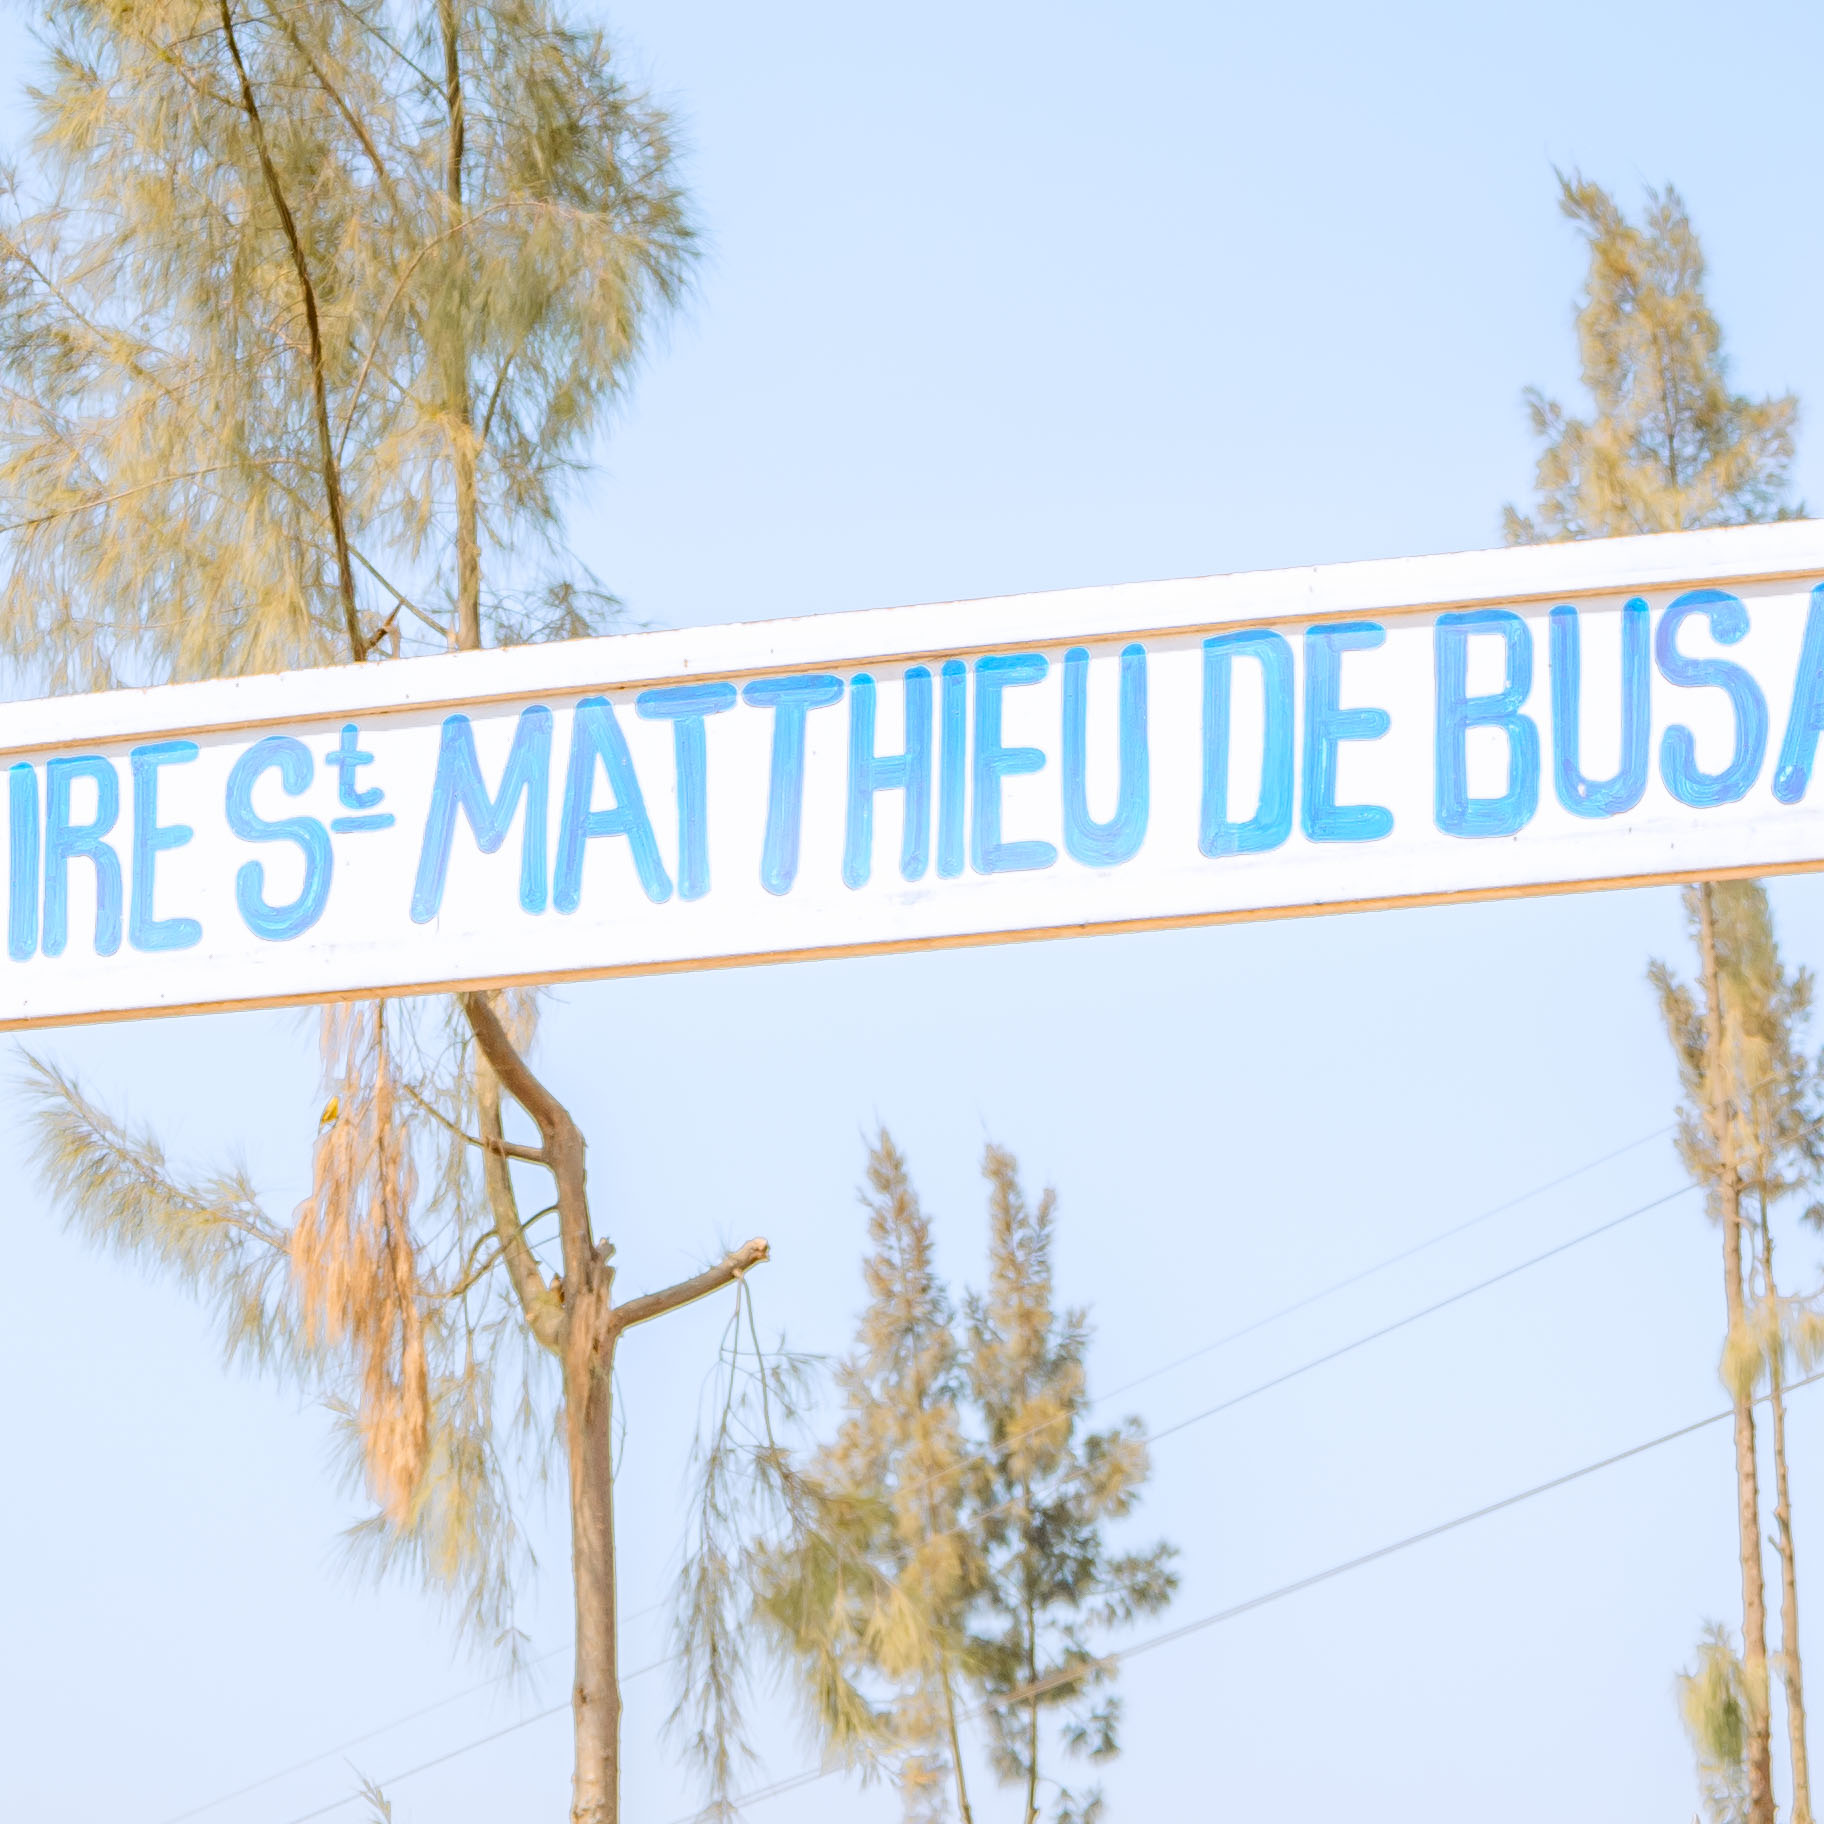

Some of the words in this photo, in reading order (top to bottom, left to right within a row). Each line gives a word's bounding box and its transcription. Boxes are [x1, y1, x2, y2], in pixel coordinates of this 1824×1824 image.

[225, 723, 396, 941] St
[409, 643, 1150, 923] MATTHIEU
[1198, 621, 1395, 858] DE
